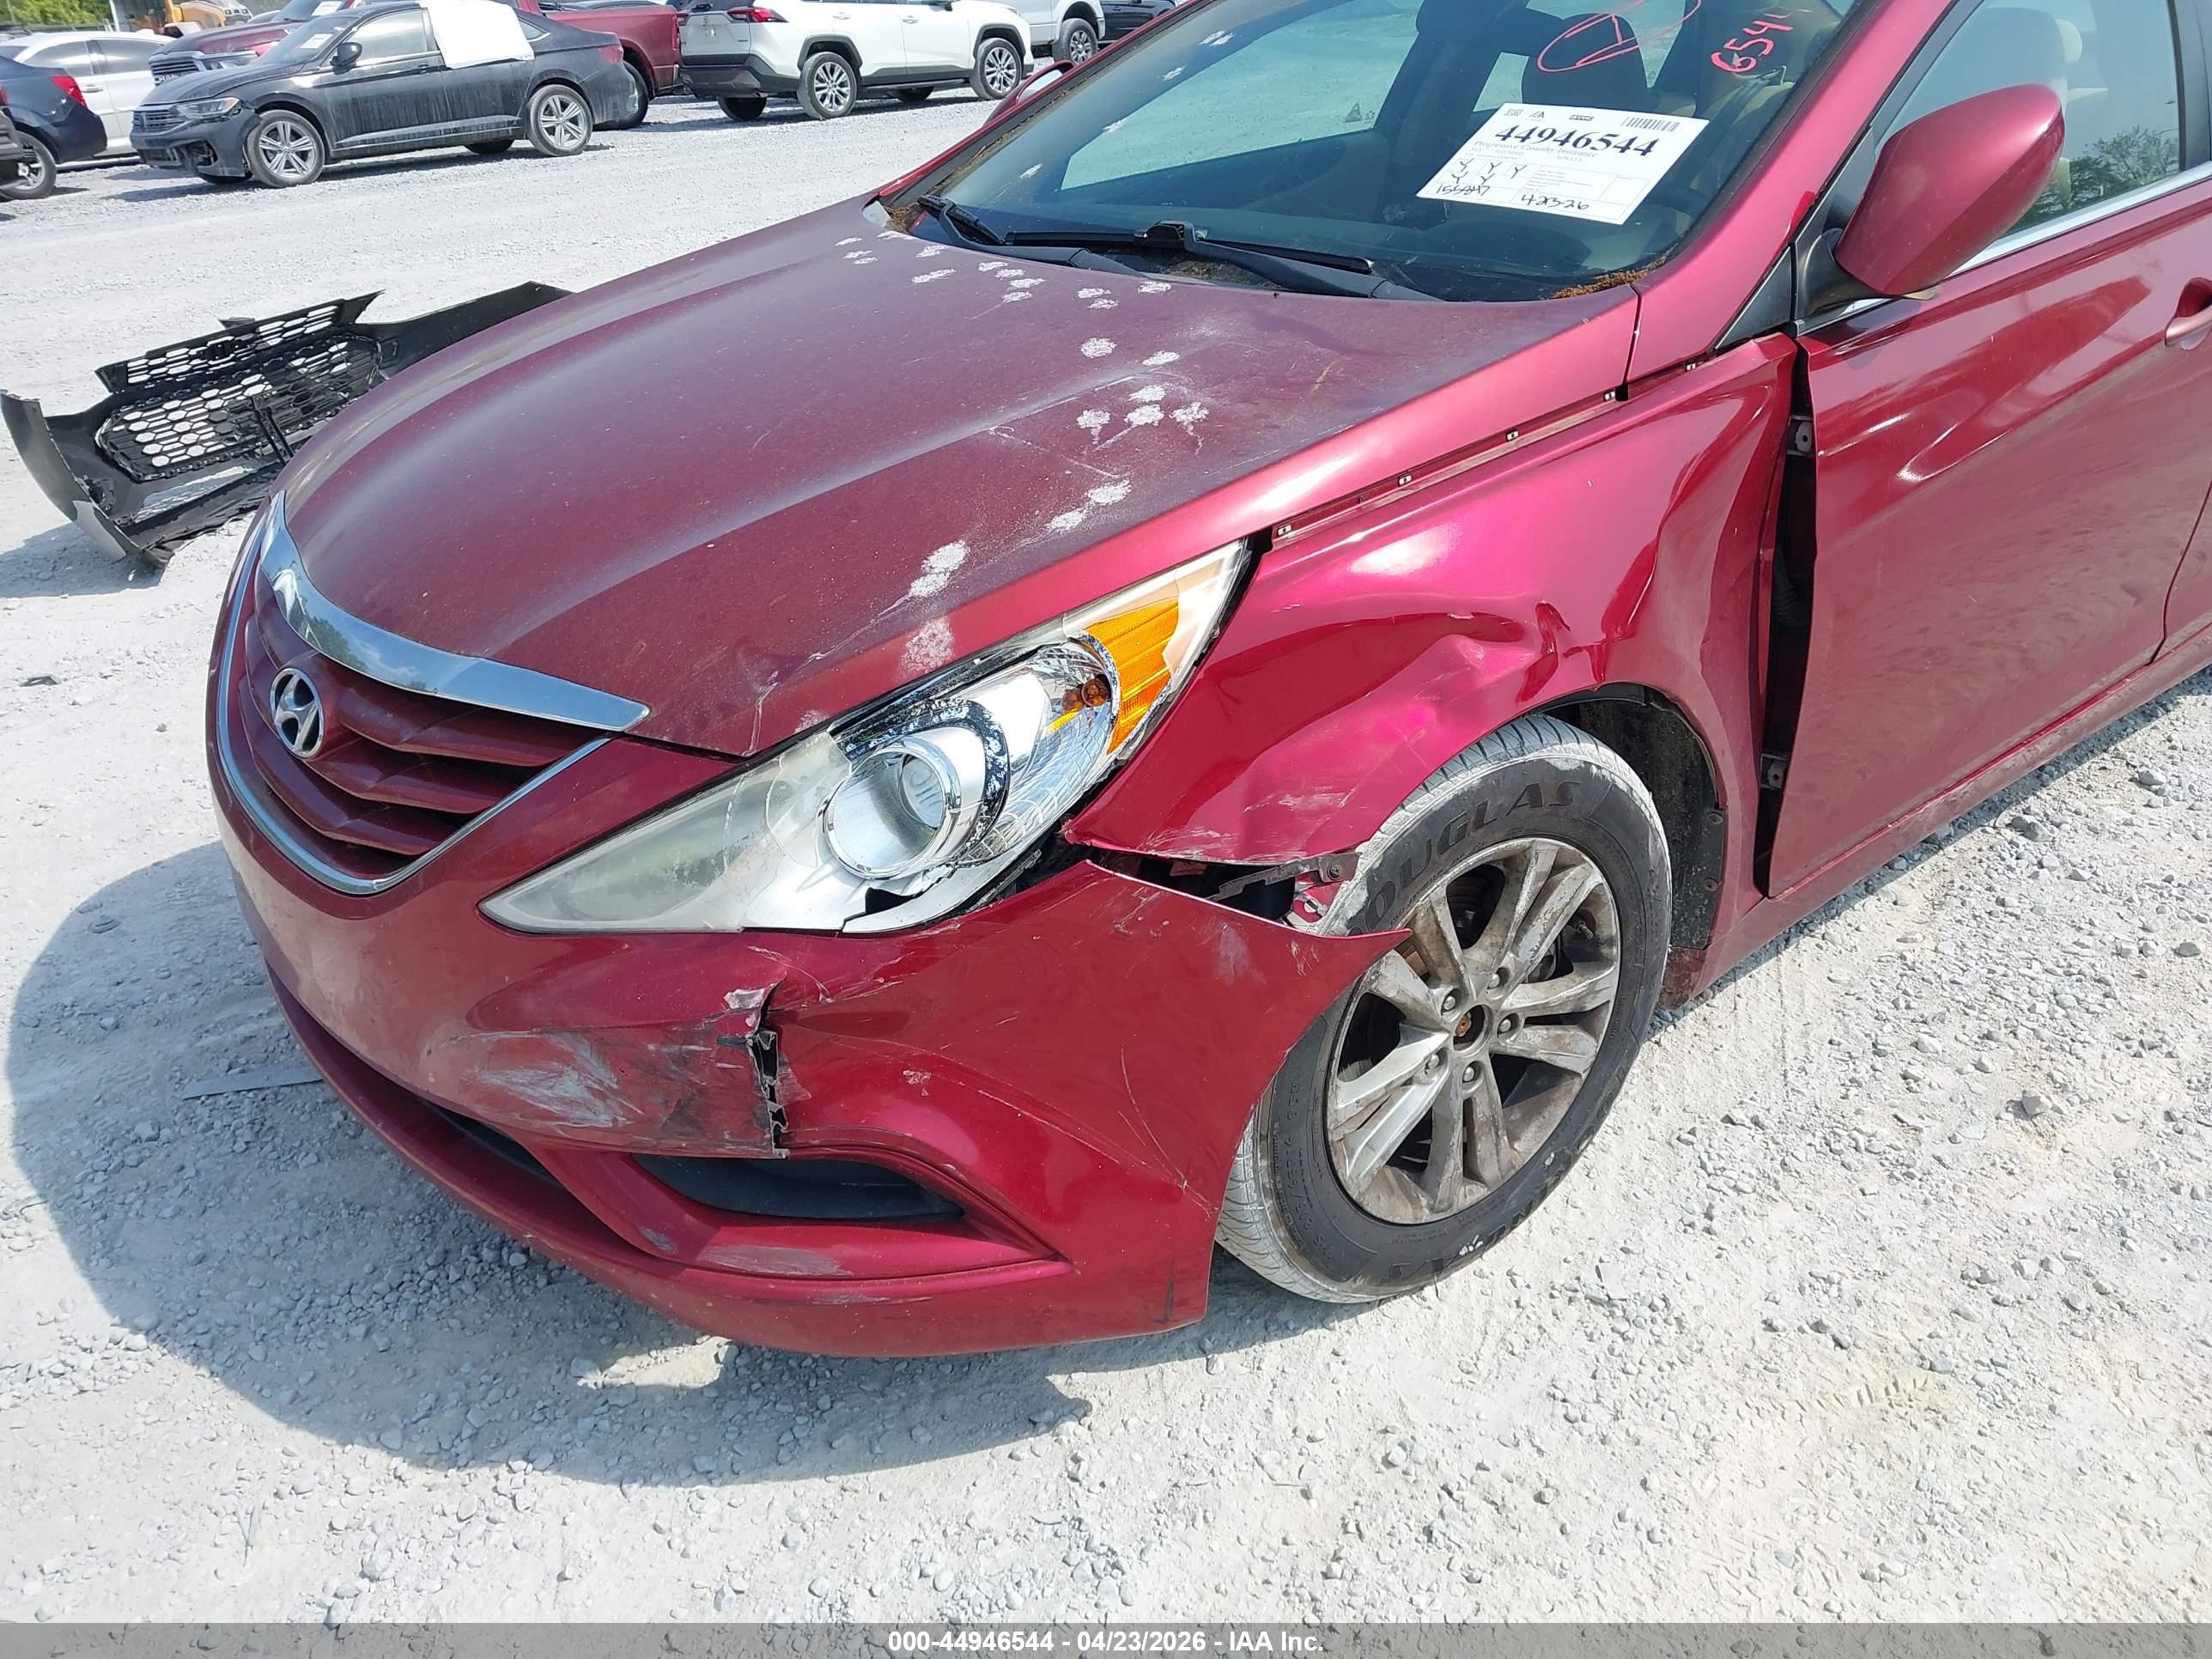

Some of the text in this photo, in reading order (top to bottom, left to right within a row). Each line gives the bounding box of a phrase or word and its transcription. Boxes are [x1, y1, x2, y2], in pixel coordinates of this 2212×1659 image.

[1495, 125, 1658, 156] 44946544
[1451, 171, 1495, 185] Y Y
[1488, 161, 1502, 173] Y
[1511, 165, 1528, 179] Y
